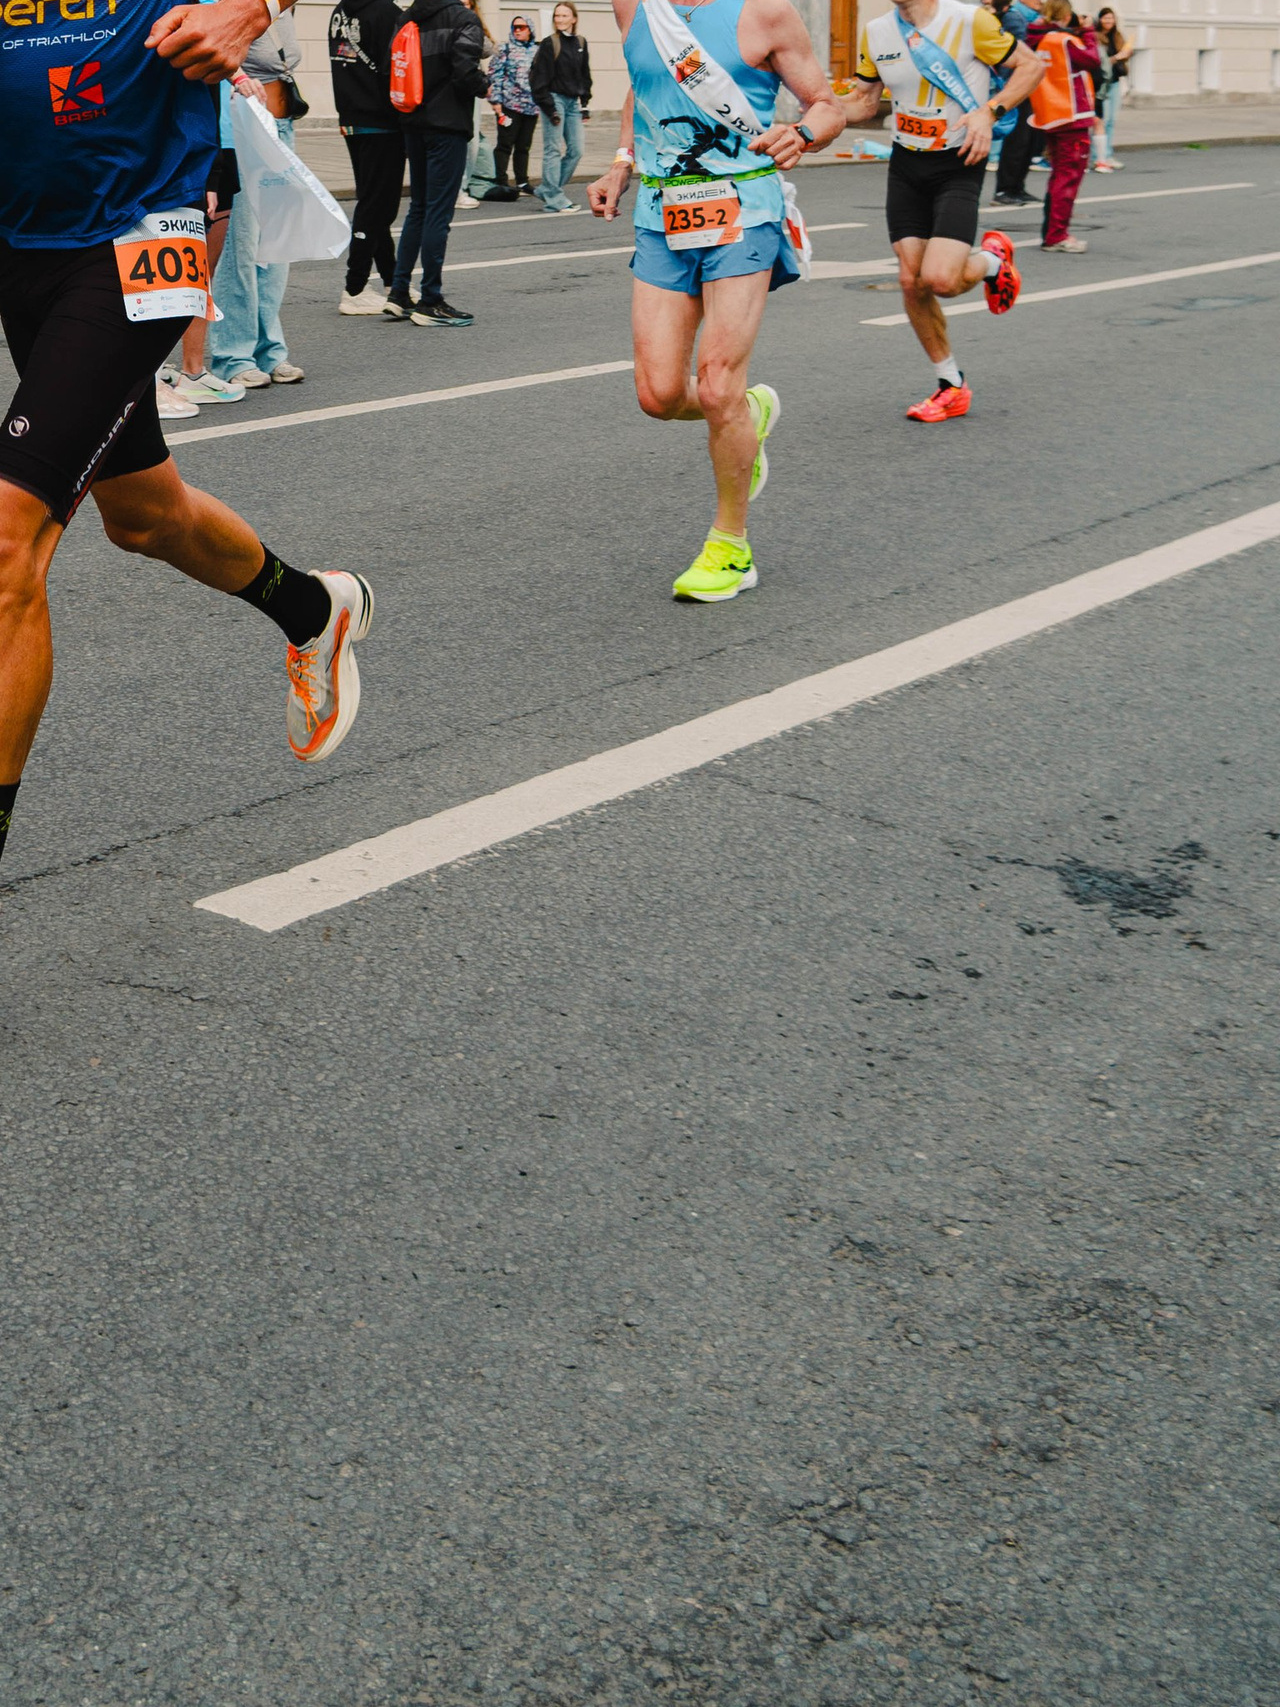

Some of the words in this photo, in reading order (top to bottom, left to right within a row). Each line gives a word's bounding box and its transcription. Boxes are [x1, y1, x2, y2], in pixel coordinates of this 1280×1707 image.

[2, 39, 24, 50] OF
[26, 27, 117, 48] TRIATHLON
[929, 61, 973, 107] DOUBLE
[900, 117, 938, 137] 253-2
[677, 188, 727, 202] ЭКИДЕН
[667, 207, 728, 231] 235-2
